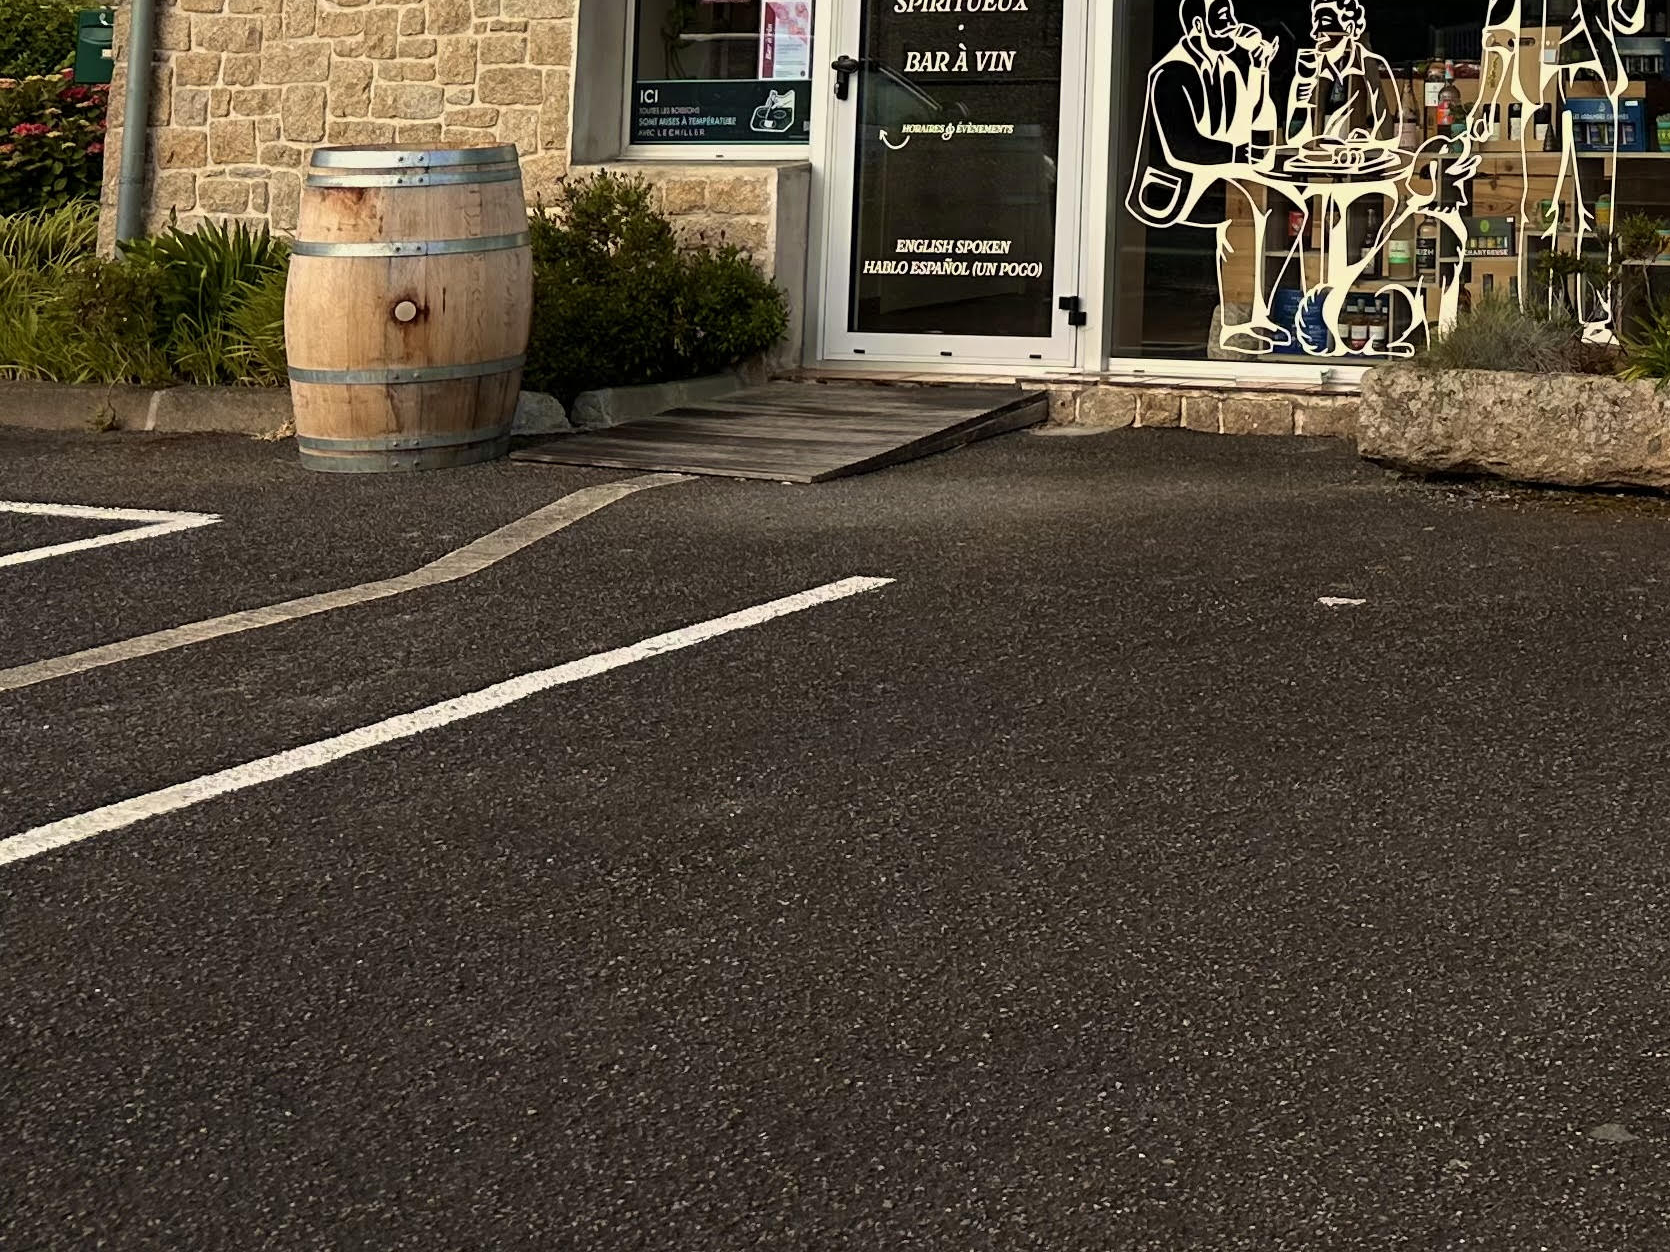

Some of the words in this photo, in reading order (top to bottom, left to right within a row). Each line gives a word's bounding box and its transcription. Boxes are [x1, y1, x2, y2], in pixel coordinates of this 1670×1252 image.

[904, 51, 950, 72] BAR
[952, 42, 969, 72] À
[975, 51, 1017, 72] VIN
[640, 89, 658, 103] ICI
[895, 239, 954, 254] ENGLISH
[955, 240, 1011, 254] SPOKEN
[863, 260, 908, 275] HABLO
[910, 258, 971, 276] ESPAÑOL
[972, 261, 997, 277] (UN
[998, 262, 1043, 278] POCO)
